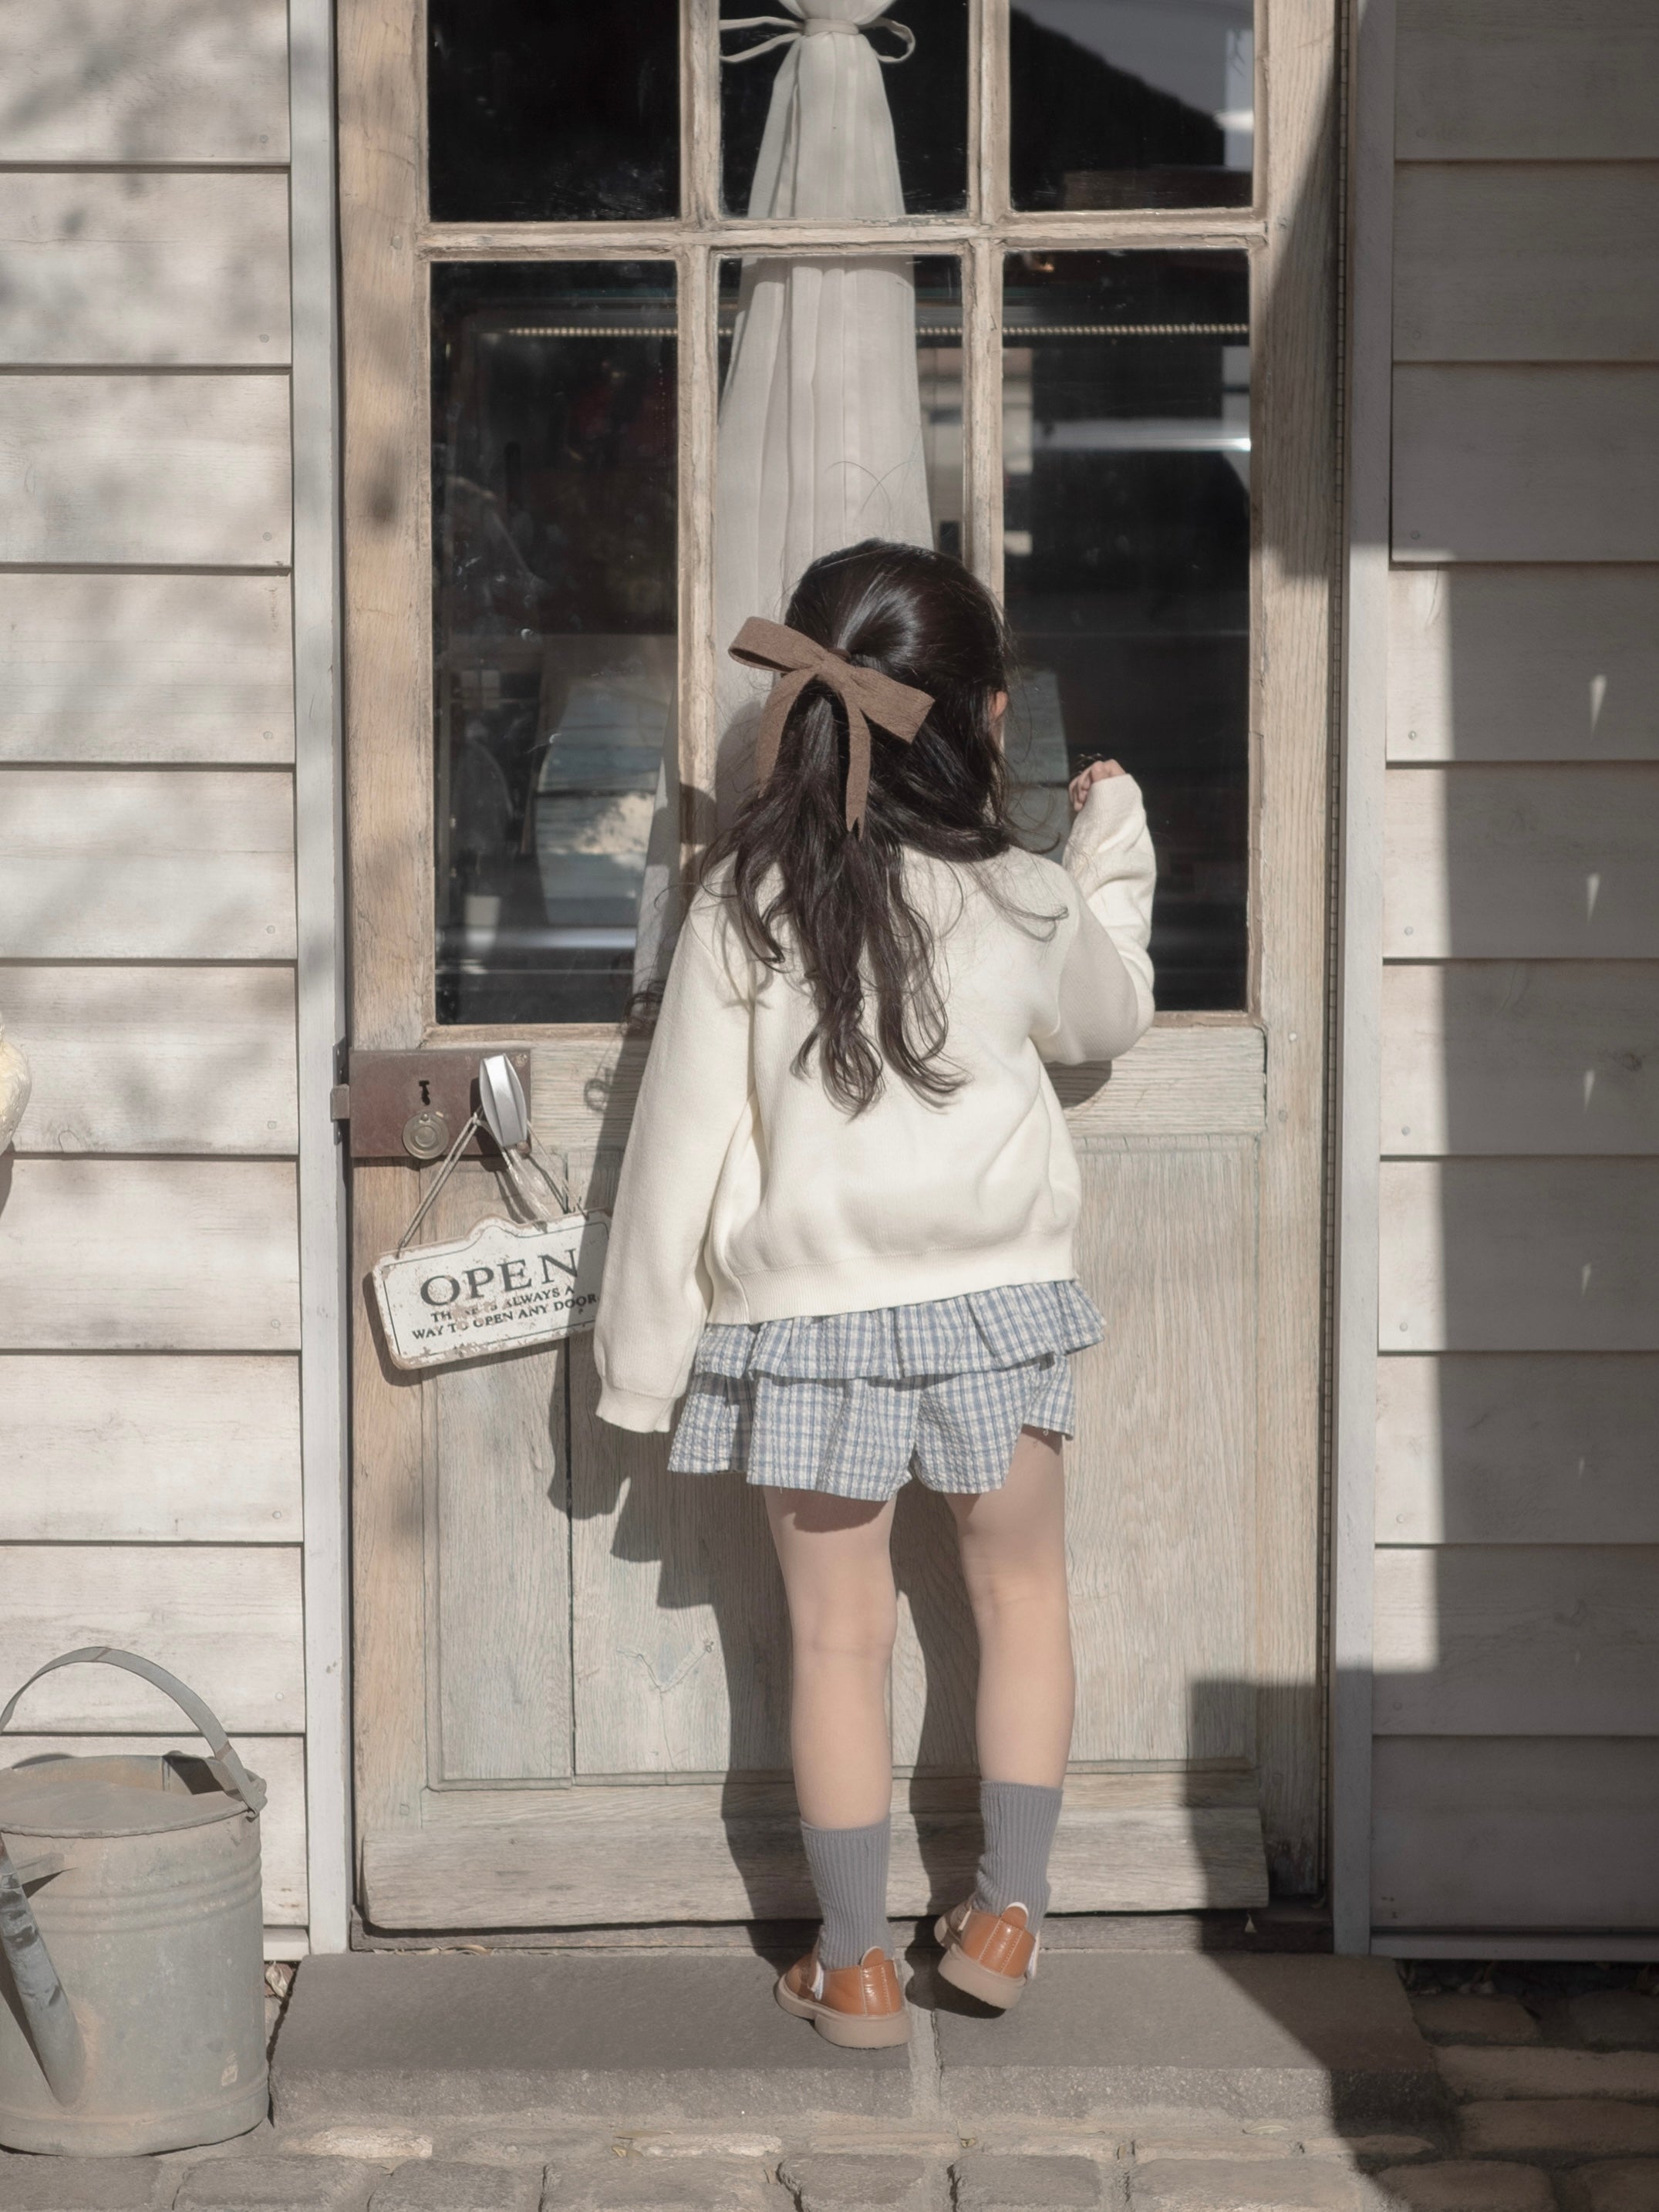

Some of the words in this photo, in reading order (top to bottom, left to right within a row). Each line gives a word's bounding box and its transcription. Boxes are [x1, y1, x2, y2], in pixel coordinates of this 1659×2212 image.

[420, 1248, 578, 1307] OPEN
[565, 1285, 575, 1295] A
[412, 1325, 443, 1340] WAY
[473, 1311, 514, 1328] OPEN
[518, 1304, 548, 1319] ANY
